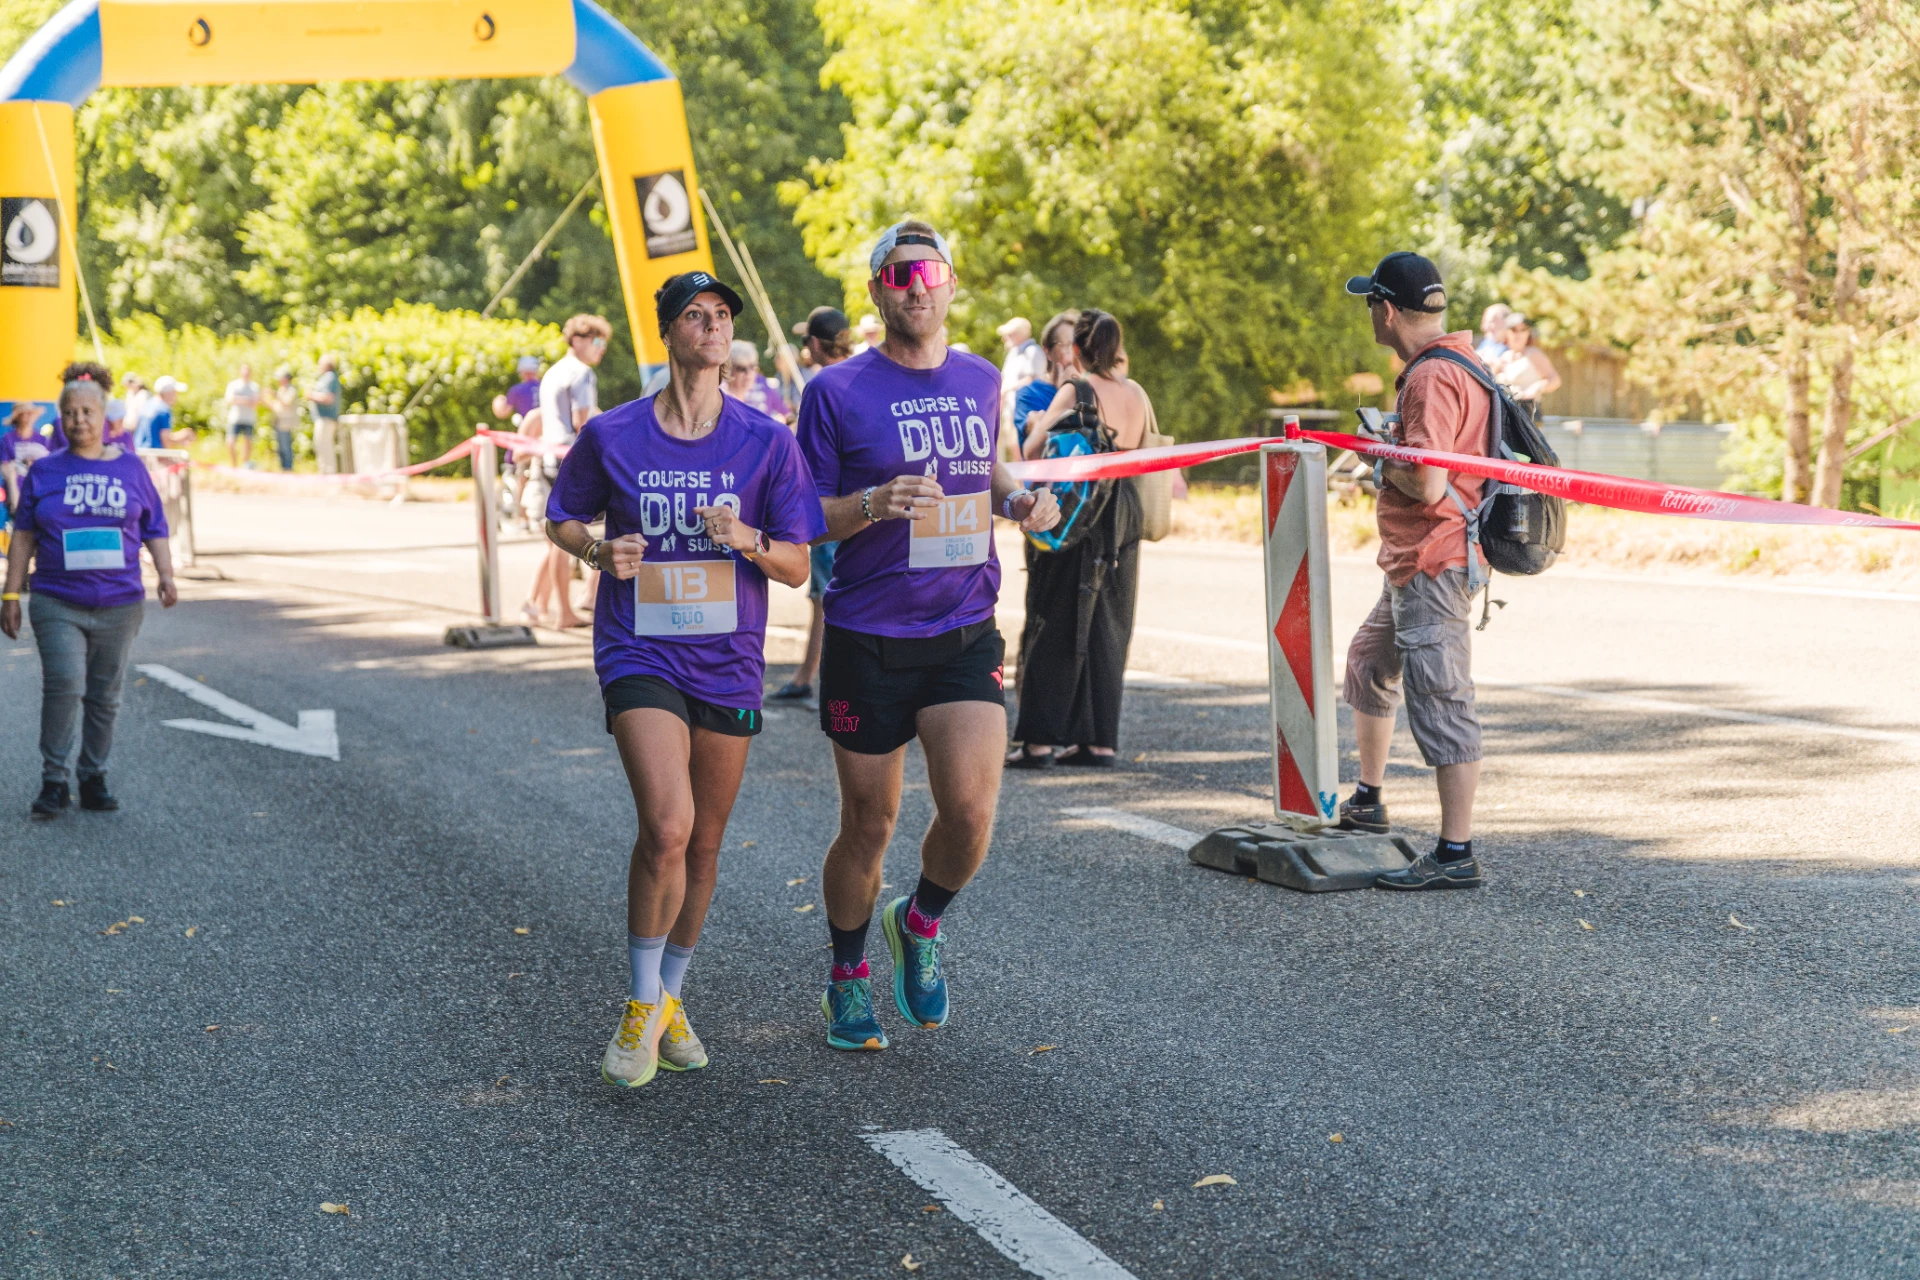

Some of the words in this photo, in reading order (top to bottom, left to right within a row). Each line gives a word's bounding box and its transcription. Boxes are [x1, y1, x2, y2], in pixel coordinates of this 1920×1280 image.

[890, 396, 960, 417] COURSE
[897, 415, 991, 462] DUO
[638, 470, 712, 488] COURSE
[949, 460, 992, 476] SUISSE
[1504, 467, 1574, 492] RAIFFEISEN
[63, 484, 127, 509] DUO
[1660, 490, 1741, 515] RAIFFEISEN
[938, 499, 979, 533] 114
[687, 538, 734, 552] SUISS
[945, 542, 974, 557] DUO
[661, 567, 708, 600] 113
[671, 611, 704, 625] DUO
